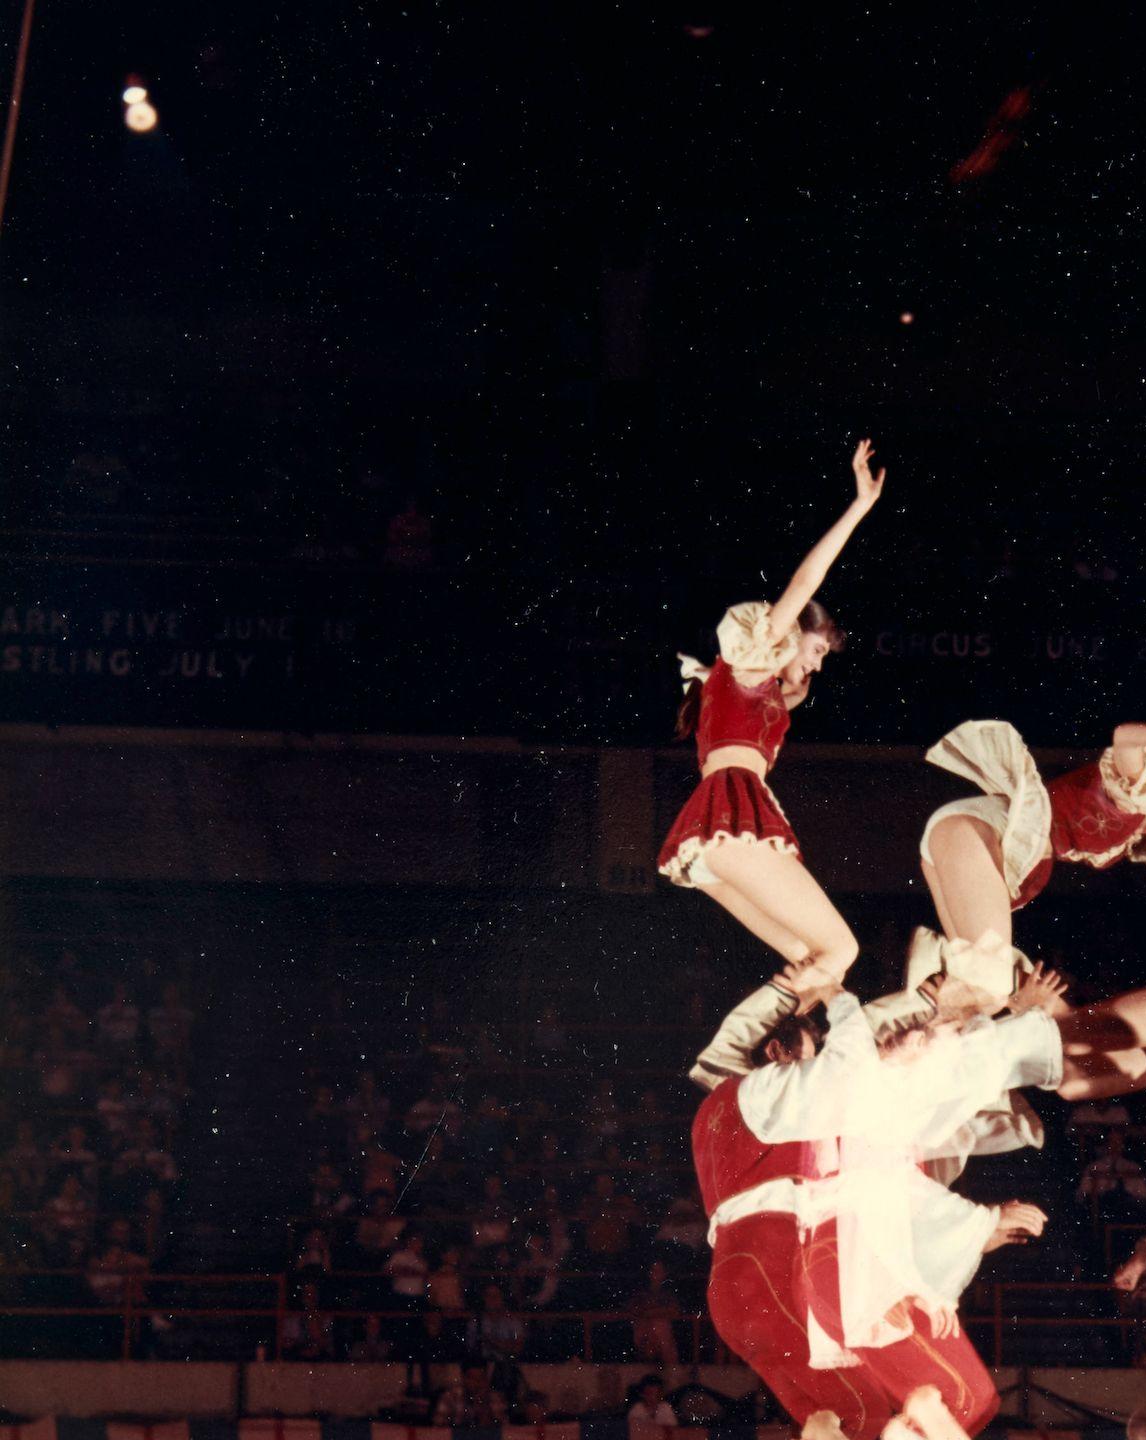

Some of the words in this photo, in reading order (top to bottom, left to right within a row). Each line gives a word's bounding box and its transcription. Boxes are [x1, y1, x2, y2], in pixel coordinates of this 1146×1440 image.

[102, 609, 179, 637] FIVE
[875, 630, 991, 657] CIRCUS
[160, 651, 255, 678] JULY
